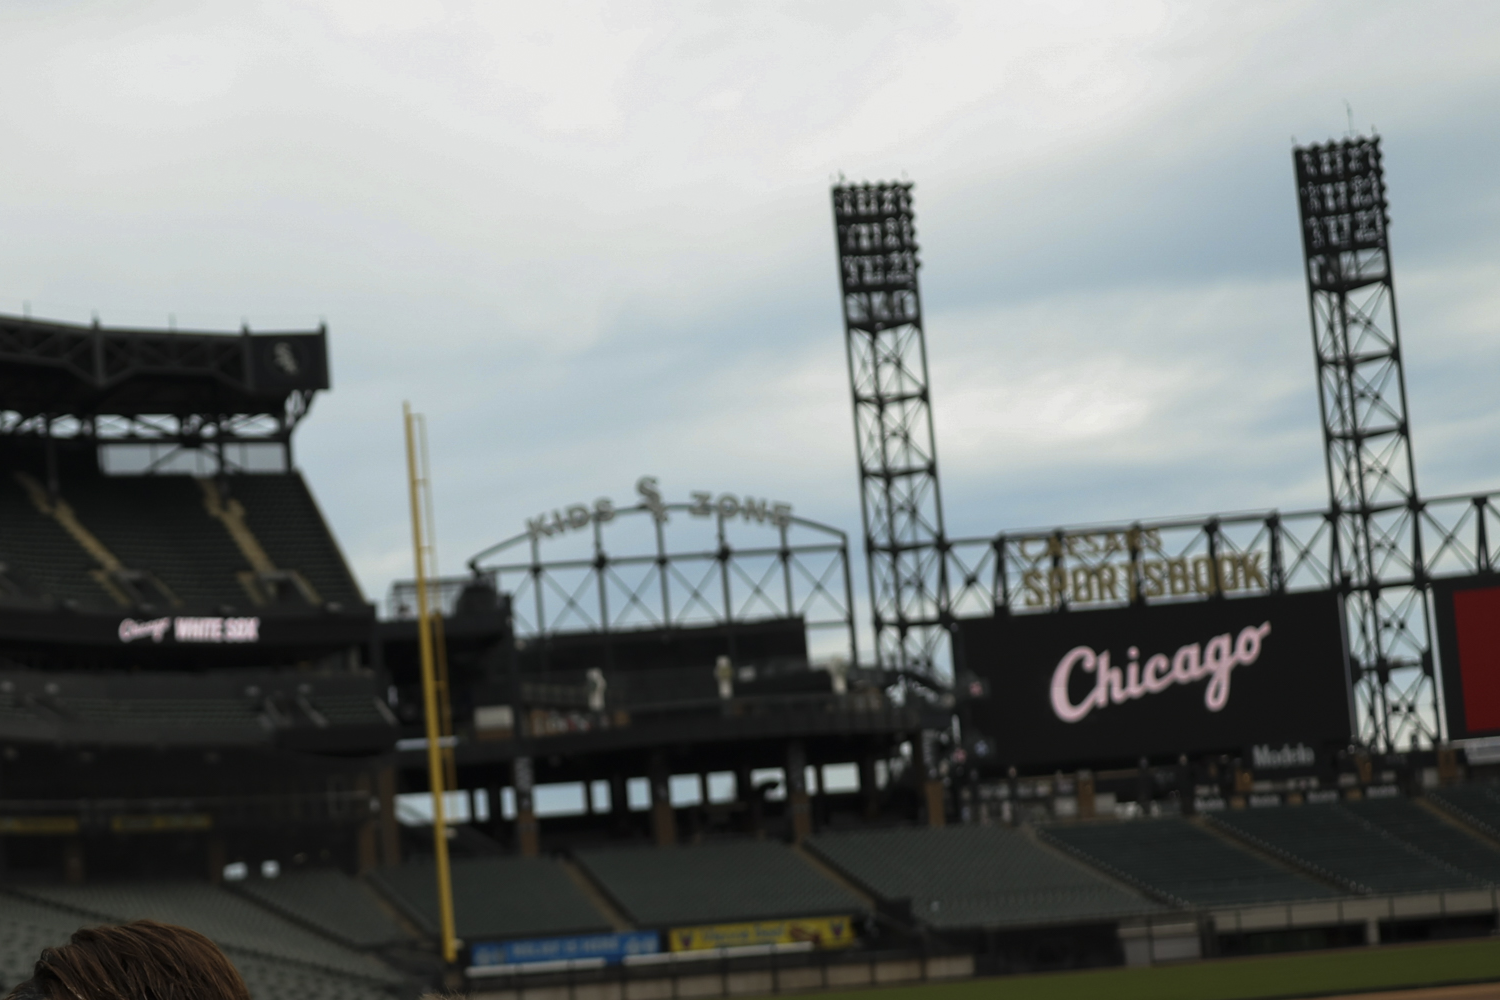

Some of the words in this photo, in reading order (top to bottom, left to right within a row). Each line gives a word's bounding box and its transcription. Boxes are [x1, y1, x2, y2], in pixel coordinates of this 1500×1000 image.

[528, 497, 615, 539] KIDS
[688, 491, 794, 528] ZONE
[1022, 551, 1268, 607] SPORTSBOOK
[1050, 620, 1272, 722] Chicago
